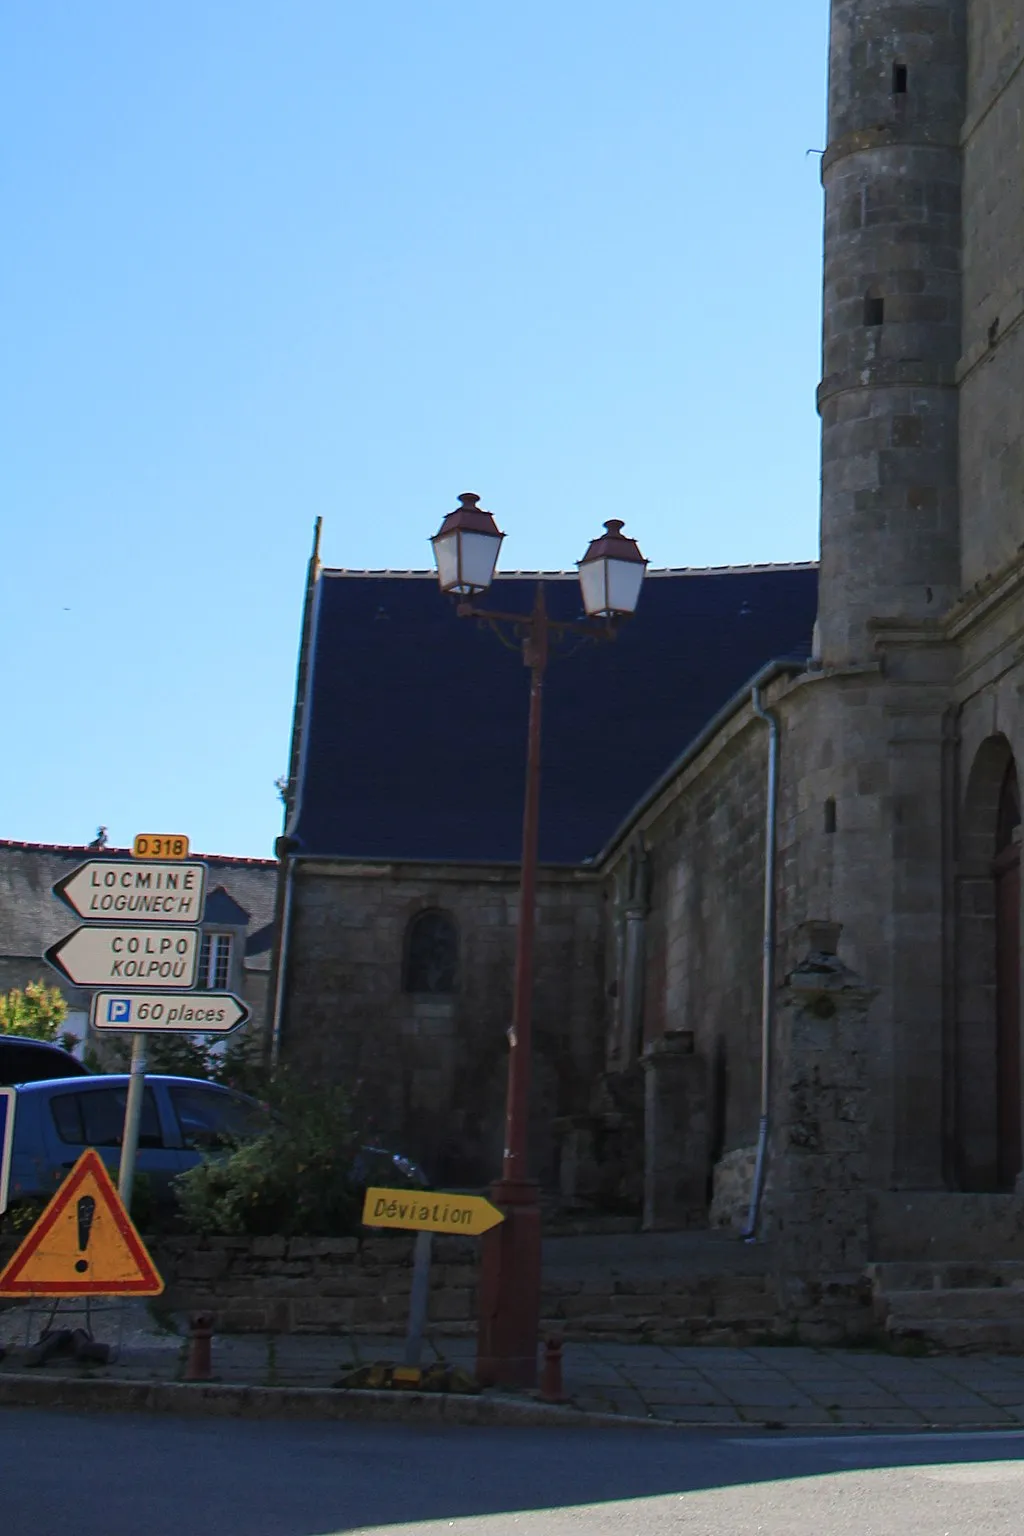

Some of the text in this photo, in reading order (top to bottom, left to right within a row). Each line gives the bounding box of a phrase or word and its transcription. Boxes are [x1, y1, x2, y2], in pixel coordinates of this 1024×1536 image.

[92, 870, 194, 890] LOCMINÉ
[112, 937, 188, 954] COLPO
[137, 1003, 164, 1020] 60
[166, 1004, 226, 1025] places
[374, 1198, 473, 1225] Déviation
